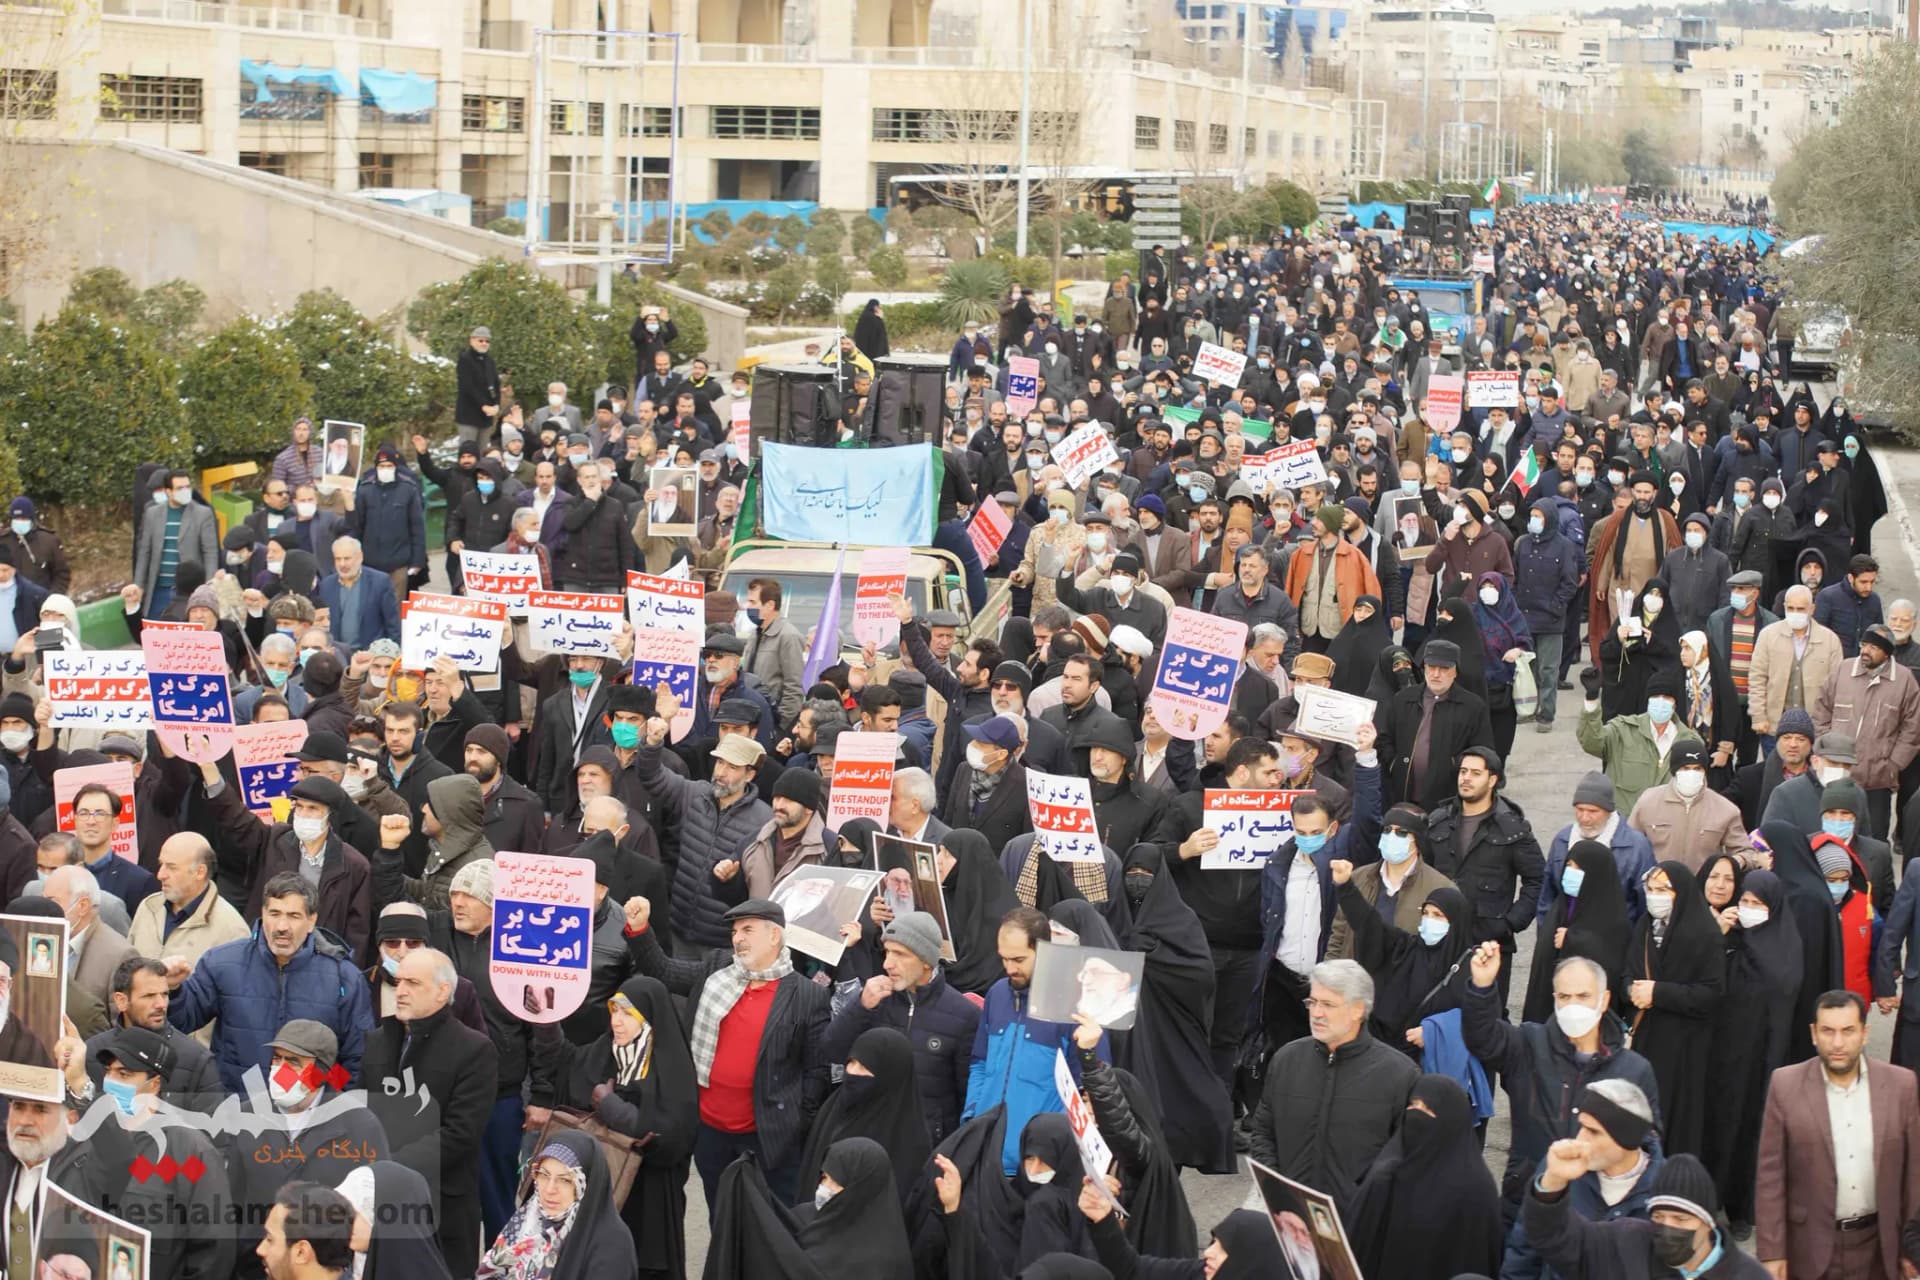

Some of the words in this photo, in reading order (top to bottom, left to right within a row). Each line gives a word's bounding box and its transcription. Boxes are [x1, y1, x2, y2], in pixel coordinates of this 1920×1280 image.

[581, 596, 599, 610] آخر
[600, 597, 608, 608] تا
[608, 598, 618, 609] ما
[655, 600, 695, 618] مطیع
[416, 617, 439, 637] امر
[540, 612, 562, 629] امر
[566, 615, 613, 633] مطیع
[440, 621, 492, 642] مطیع
[552, 636, 609, 653] رهبریم
[116, 660, 147, 676] مرگ
[1168, 652, 1188, 668] بر
[1190, 654, 1229, 677] مرگ
[101, 662, 112, 676] بر
[638, 666, 654, 682] بر
[655, 664, 689, 685] مرگ
[51, 679, 100, 700] اسرائیل
[102, 684, 116, 700] بر
[158, 678, 174, 696] بر
[177, 674, 220, 697] مرگ
[1163, 668, 1227, 699] امریکا
[104, 709, 114, 723] بر
[118, 706, 150, 723] مرگ
[158, 698, 225, 722] امریکا
[249, 770, 264, 787] بر
[832, 794, 847, 803] WE
[1211, 793, 1227, 809] ایم
[1228, 793, 1265, 808] ایستاده
[1266, 792, 1288, 809] آخر
[834, 806, 845, 815] TO
[847, 806, 863, 816] THE
[864, 807, 883, 817] END
[1062, 810, 1093, 832] مرگ
[1219, 814, 1244, 838] امر
[1248, 814, 1294, 838] طیع
[502, 908, 524, 929] بر
[529, 905, 580, 934] مرگ
[500, 933, 582, 965] امریکا
[492, 965, 523, 976] DOWN
[526, 968, 551, 979] WITH
[553, 971, 578, 982] U.S.A
